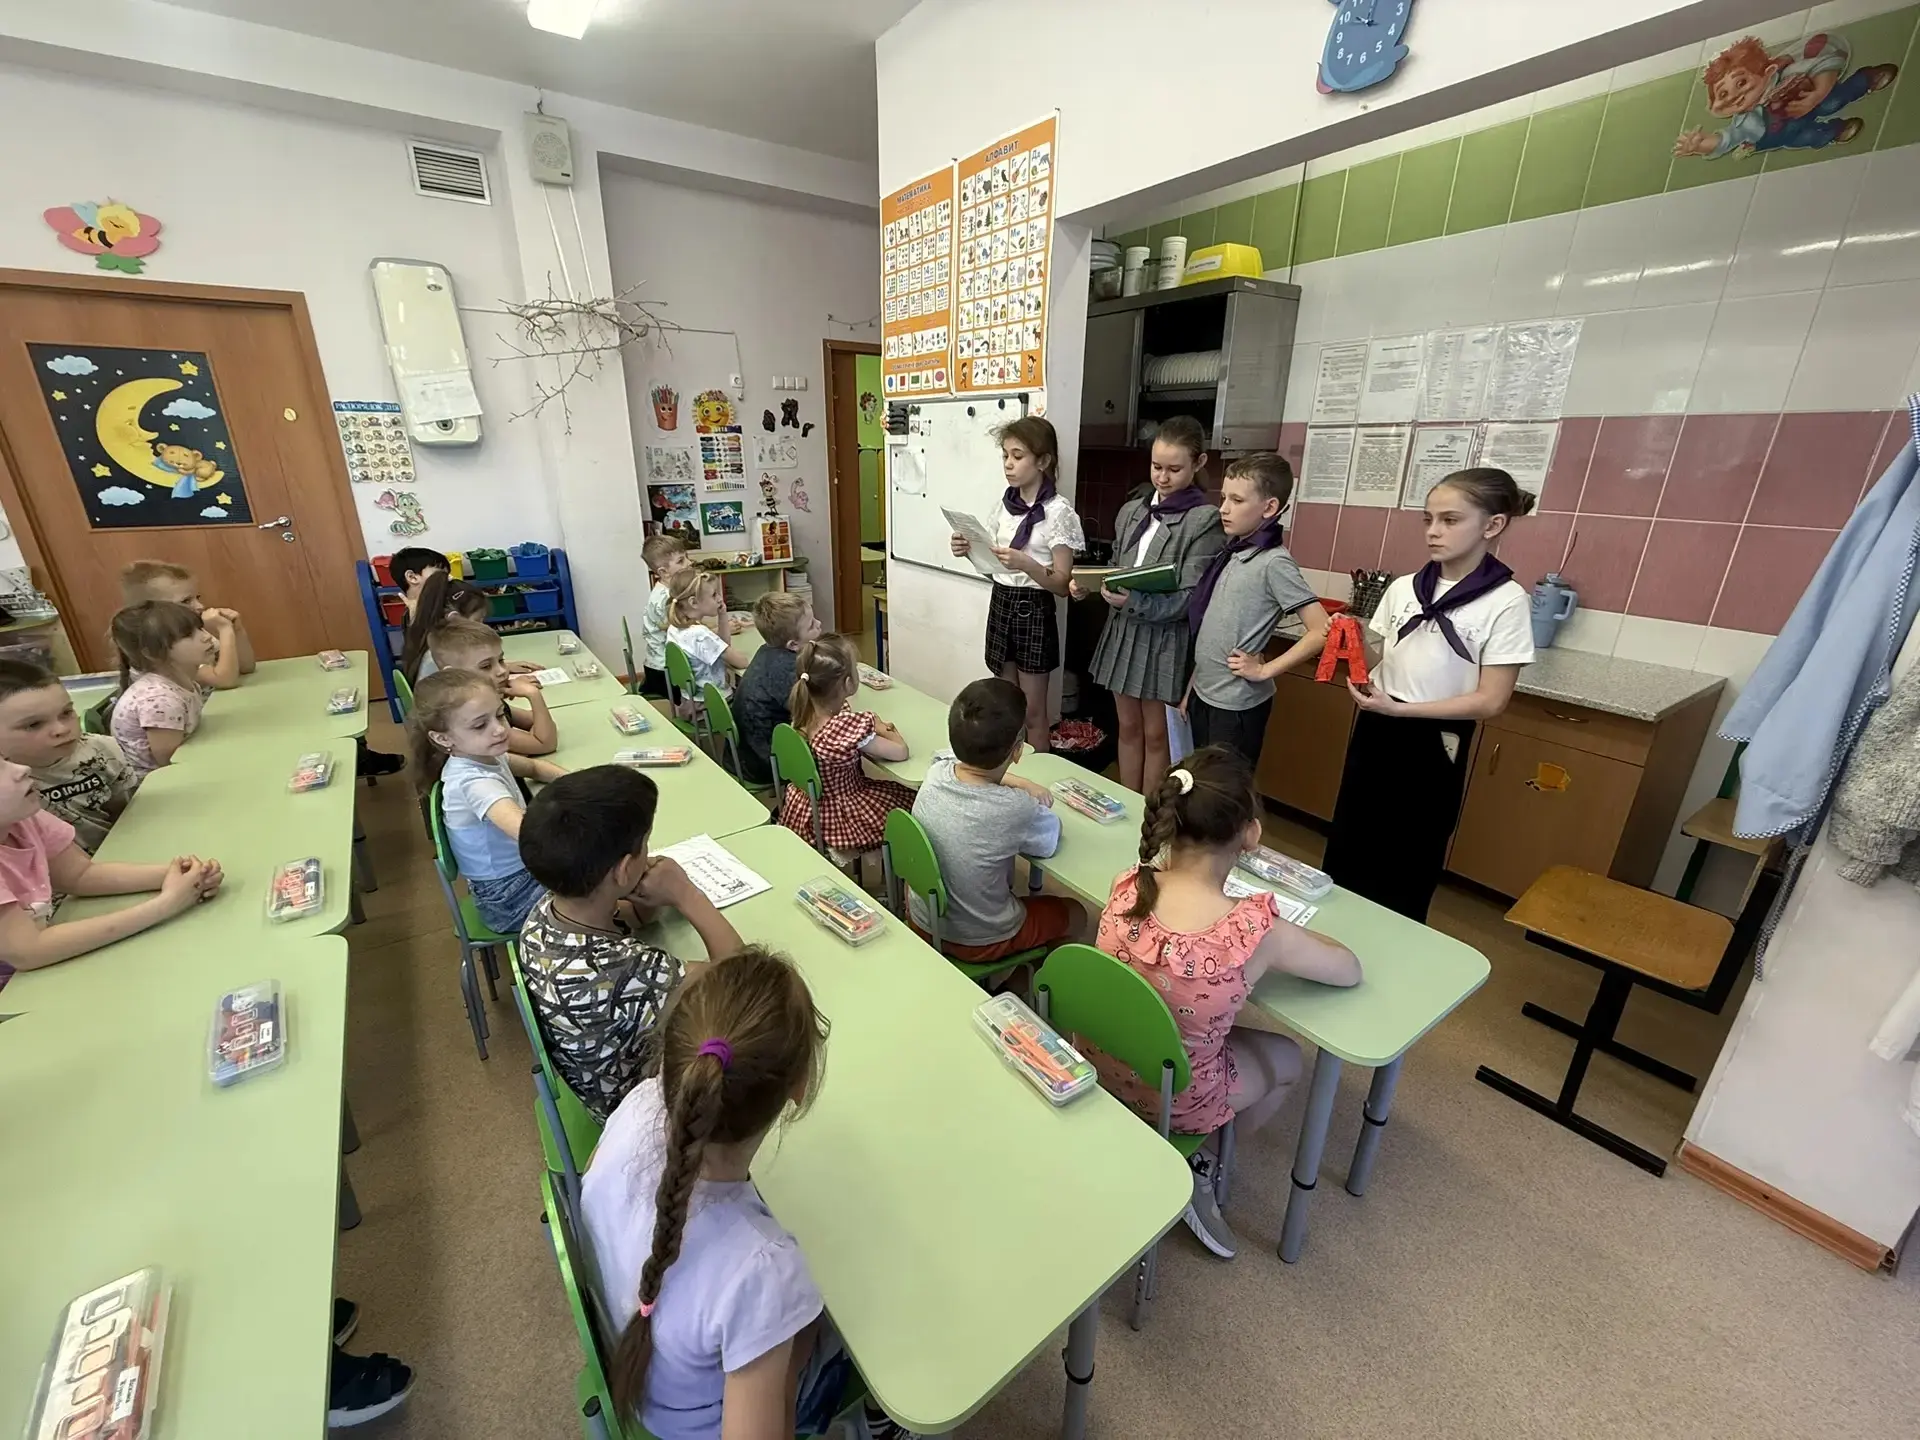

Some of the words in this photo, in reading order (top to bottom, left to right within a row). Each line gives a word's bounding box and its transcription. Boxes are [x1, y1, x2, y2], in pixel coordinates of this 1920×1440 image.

[1396, 2, 1404, 16] 3
[1339, 11, 1351, 25] 10
[1387, 23, 1396, 36] 4
[1336, 32, 1344, 43] 9
[1337, 48, 1345, 59] 8
[1375, 41, 1383, 53] 5
[1346, 53, 1353, 65] 7
[1360, 52, 1367, 63] 6
[985, 140, 1019, 163] АЛФАВИТ
[897, 182, 932, 204] МАТЕМАТИКА
[1314, 616, 1368, 684] А
